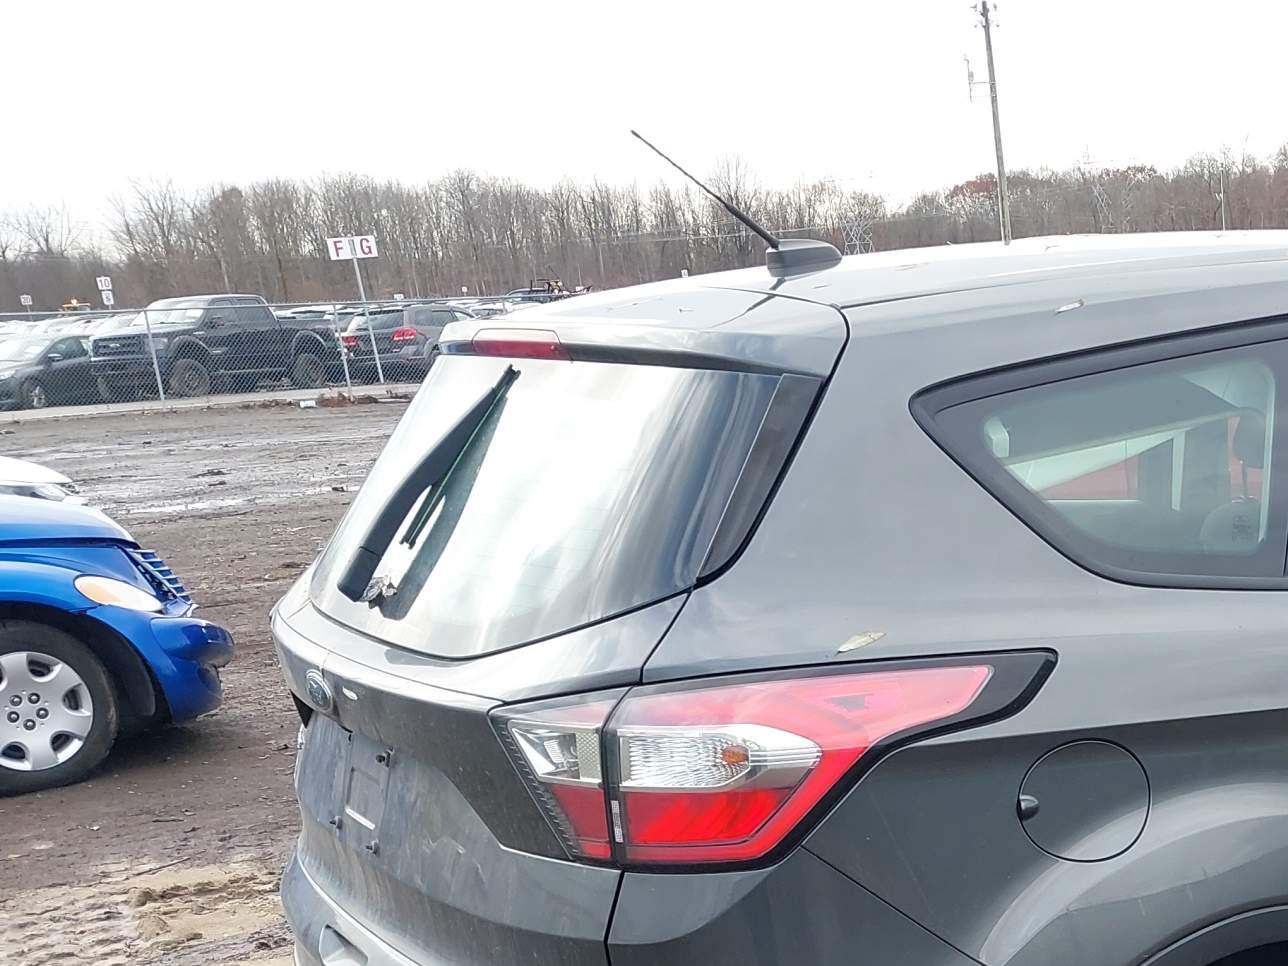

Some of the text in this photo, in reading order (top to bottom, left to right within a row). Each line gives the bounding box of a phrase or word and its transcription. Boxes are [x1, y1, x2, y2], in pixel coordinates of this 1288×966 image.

[333, 238, 373, 257] F G
[99, 278, 111, 289] 10
